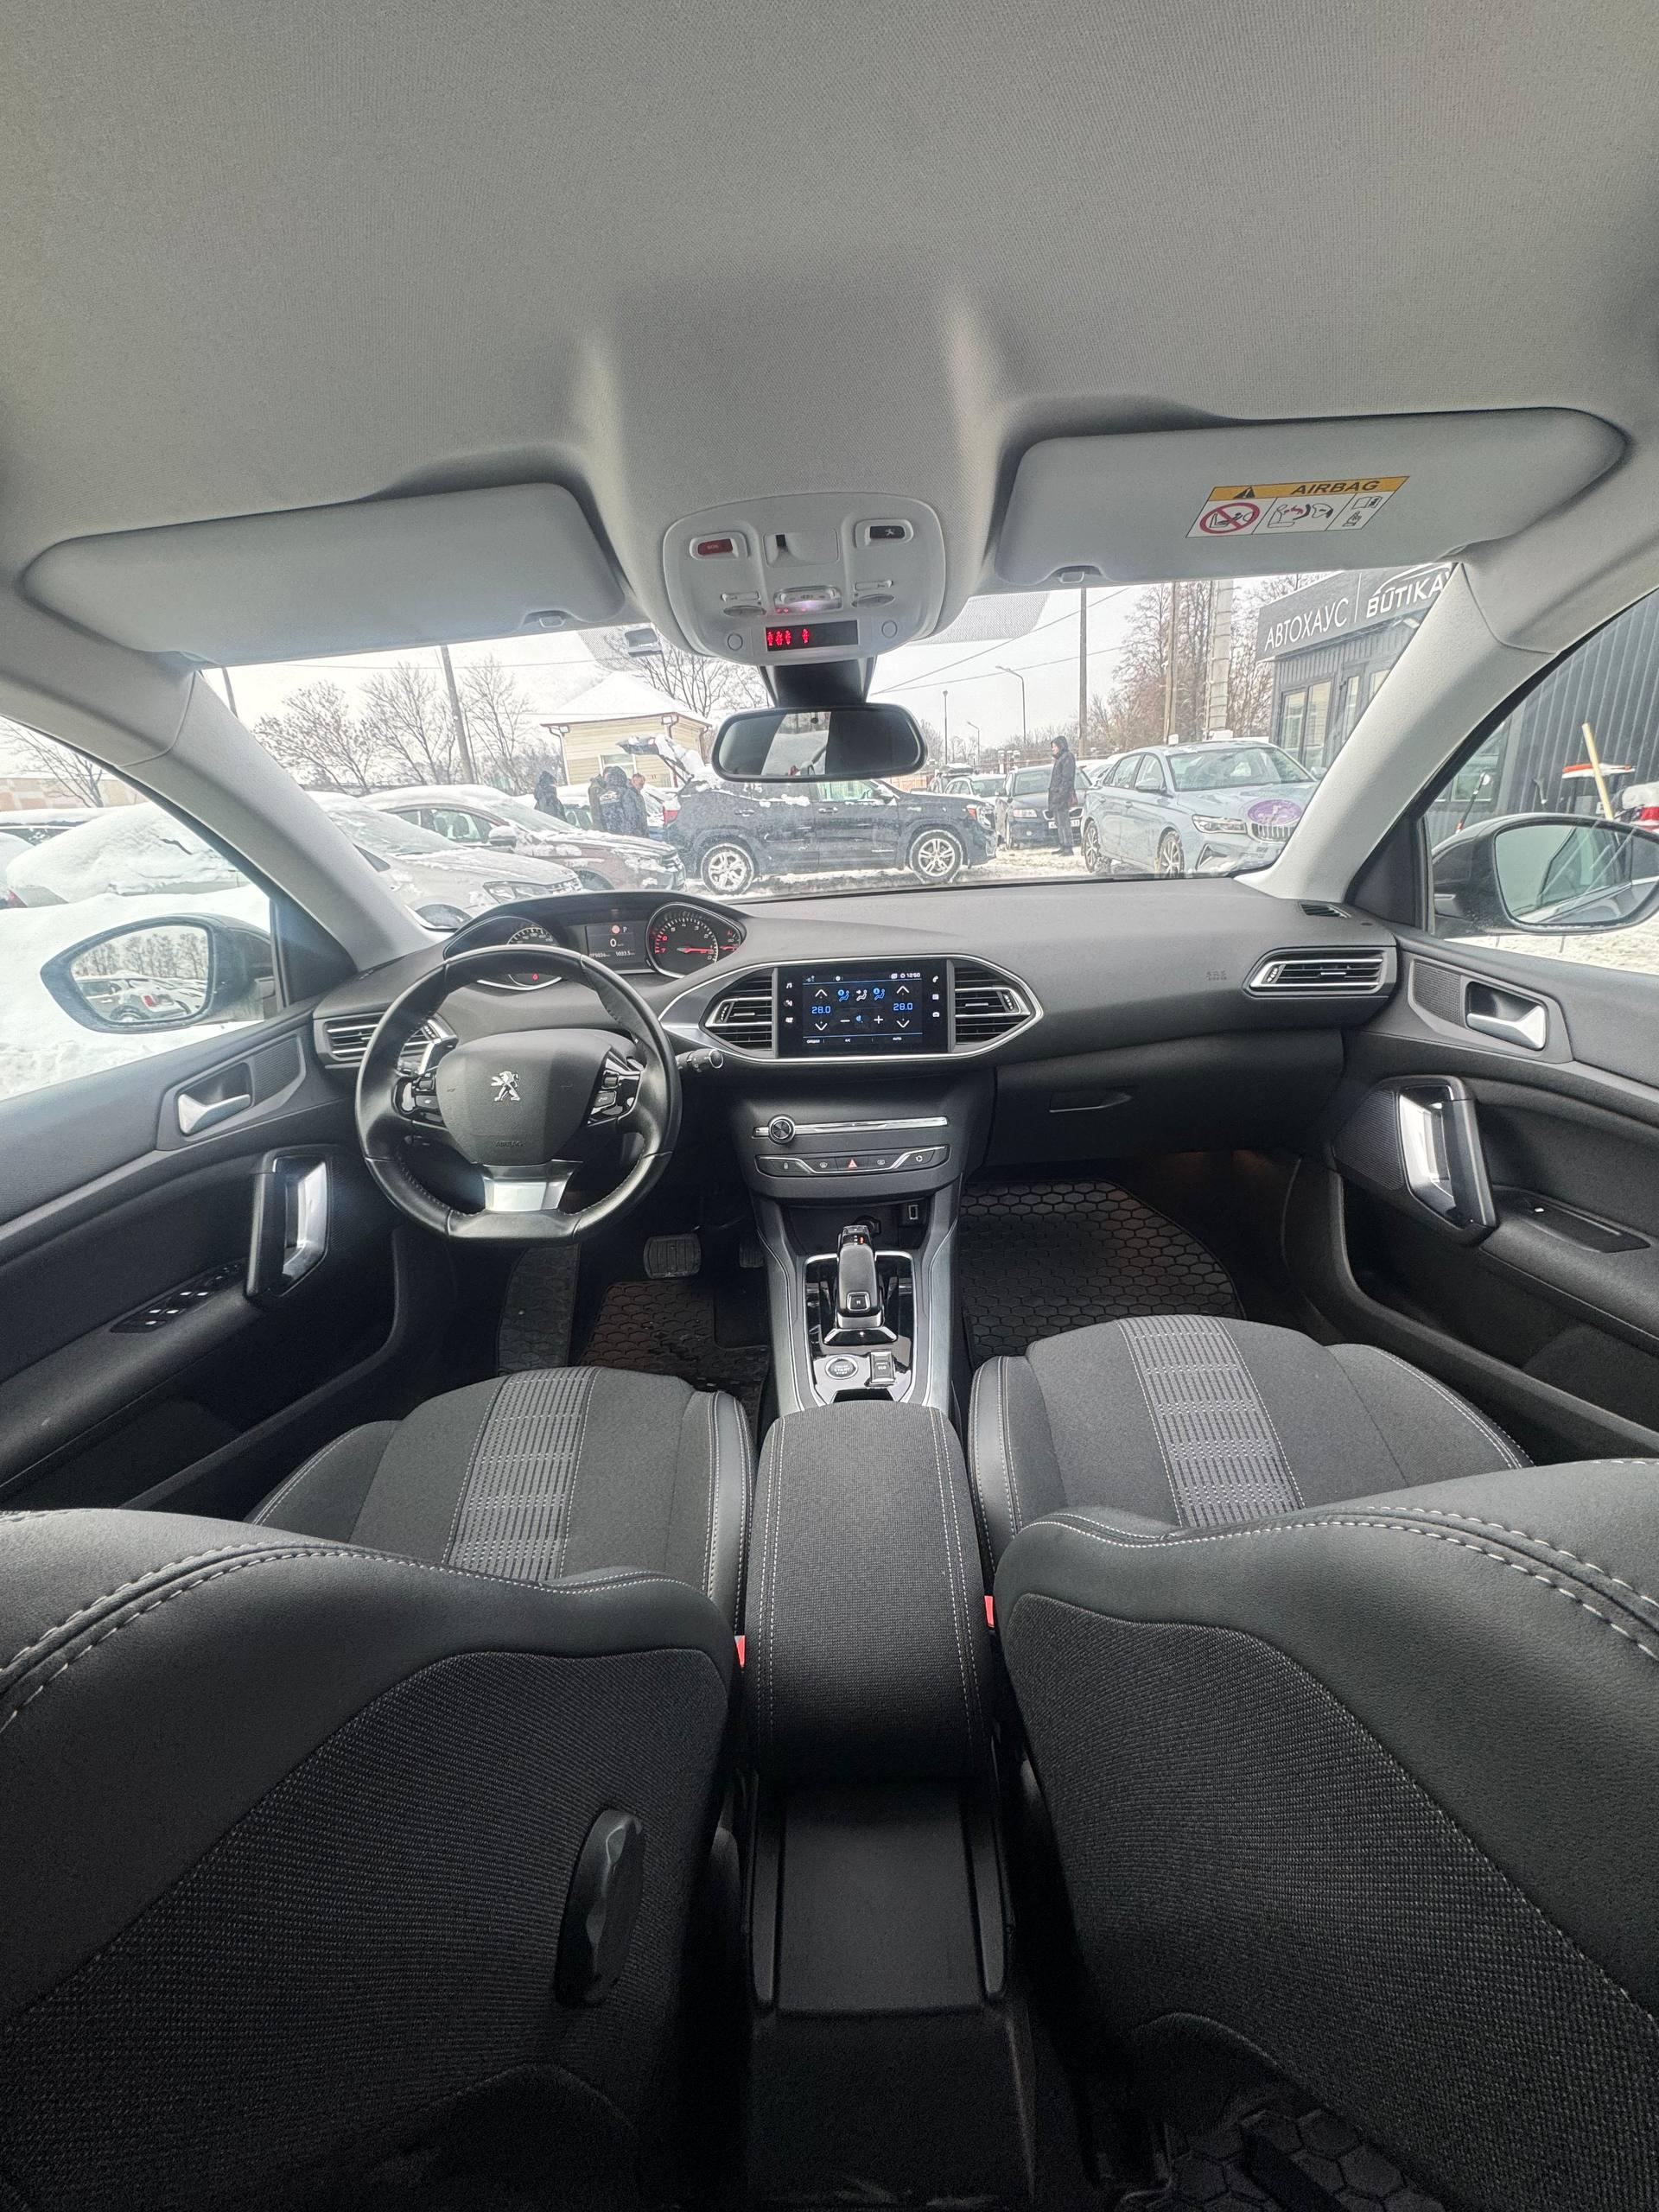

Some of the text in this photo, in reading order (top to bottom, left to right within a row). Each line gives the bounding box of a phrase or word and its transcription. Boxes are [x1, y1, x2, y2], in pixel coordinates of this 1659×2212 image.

[1290, 480, 1381, 496] AIRBAG
[1264, 597, 1349, 652] АВТОХАУС
[609, 938, 617, 948] 0
[811, 1006, 831, 1014] 28.0
[893, 1002, 913, 1011] 28.0
